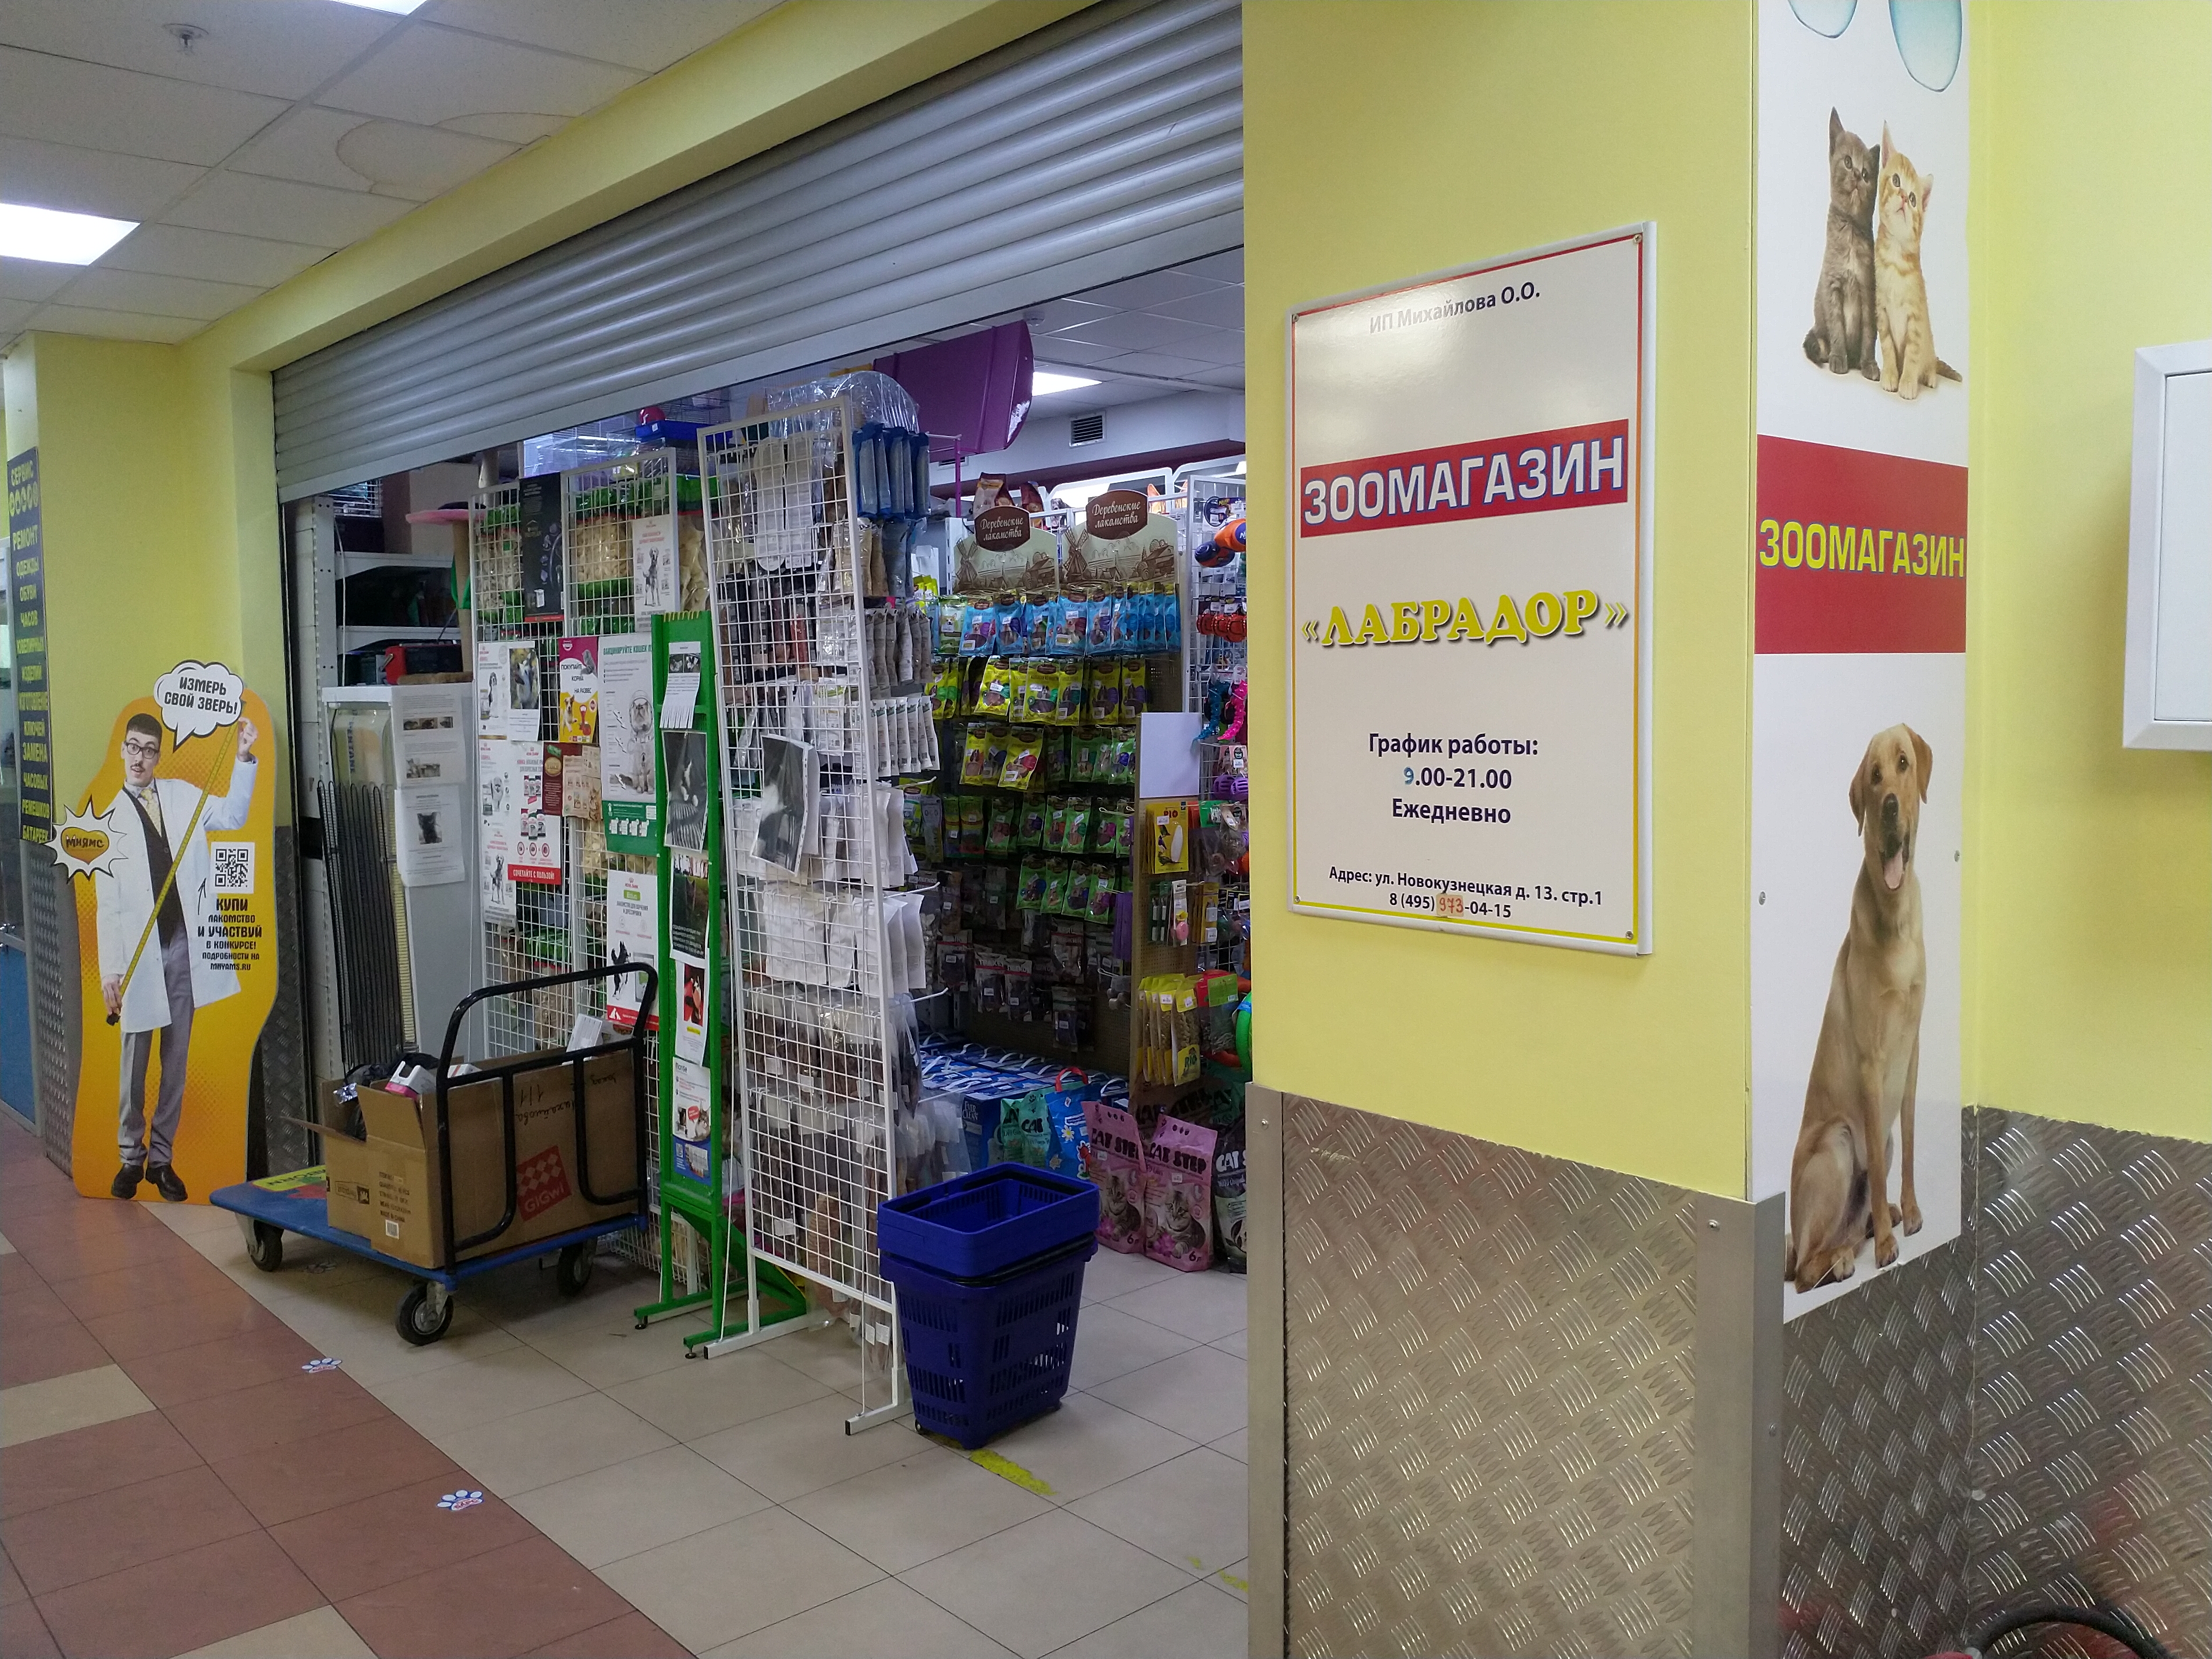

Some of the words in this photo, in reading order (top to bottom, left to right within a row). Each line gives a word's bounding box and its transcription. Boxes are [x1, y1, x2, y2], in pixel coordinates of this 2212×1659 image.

[1369, 313, 1393, 334] ИП
[1397, 292, 1496, 329] Михайлова
[1501, 282, 1540, 305] О.О.
[1303, 436, 1625, 526] ЗООМАГАЗИН
[1093, 501, 1141, 521] Деревенские
[1095, 512, 1138, 528] лакомства
[980, 516, 1024, 533] Деревенские
[983, 527, 1023, 541] лакомства
[13, 525, 38, 550] РЕМОНТ
[1759, 518, 1964, 577] ЗООМАГАЗИН
[21, 610, 38, 627] ЧАСОВ
[1301, 590, 1627, 646] «ЛАБРАДОР»
[180, 676, 226, 695] ИЗМЕРЬ
[164, 692, 194, 708] СВОЙ
[198, 697, 238, 714] ЗВЕРЬ!
[23, 742, 48, 762] ЗАМЕНА
[1369, 733, 1443, 758] График
[1448, 733, 1538, 759] работы:
[1404, 767, 1512, 789] 9.00-21.00
[1393, 798, 1511, 824] Ежедневно
[1329, 866, 1372, 883] Адрес:
[1375, 873, 1394, 887] ул.
[1397, 873, 1512, 896] Новокузнецкая
[1515, 887, 1530, 900] д.
[1535, 885, 1557, 901] 13.
[1562, 891, 1601, 907] стр.1
[216, 899, 248, 911] КУПИ
[1389, 893, 1397, 905] 8
[1401, 893, 1435, 911] (495)
[198, 926, 204, 937] И
[208, 925, 262, 937] УЧАСТВУЙ
[214, 941, 256, 949] КОНКУРСЕ!
[515, 1100, 575, 1126] ихайлова
[1150, 1142, 1171, 1163] CAT
[1173, 1151, 1207, 1175] STEP
[1216, 1151, 1239, 1172] CAT
